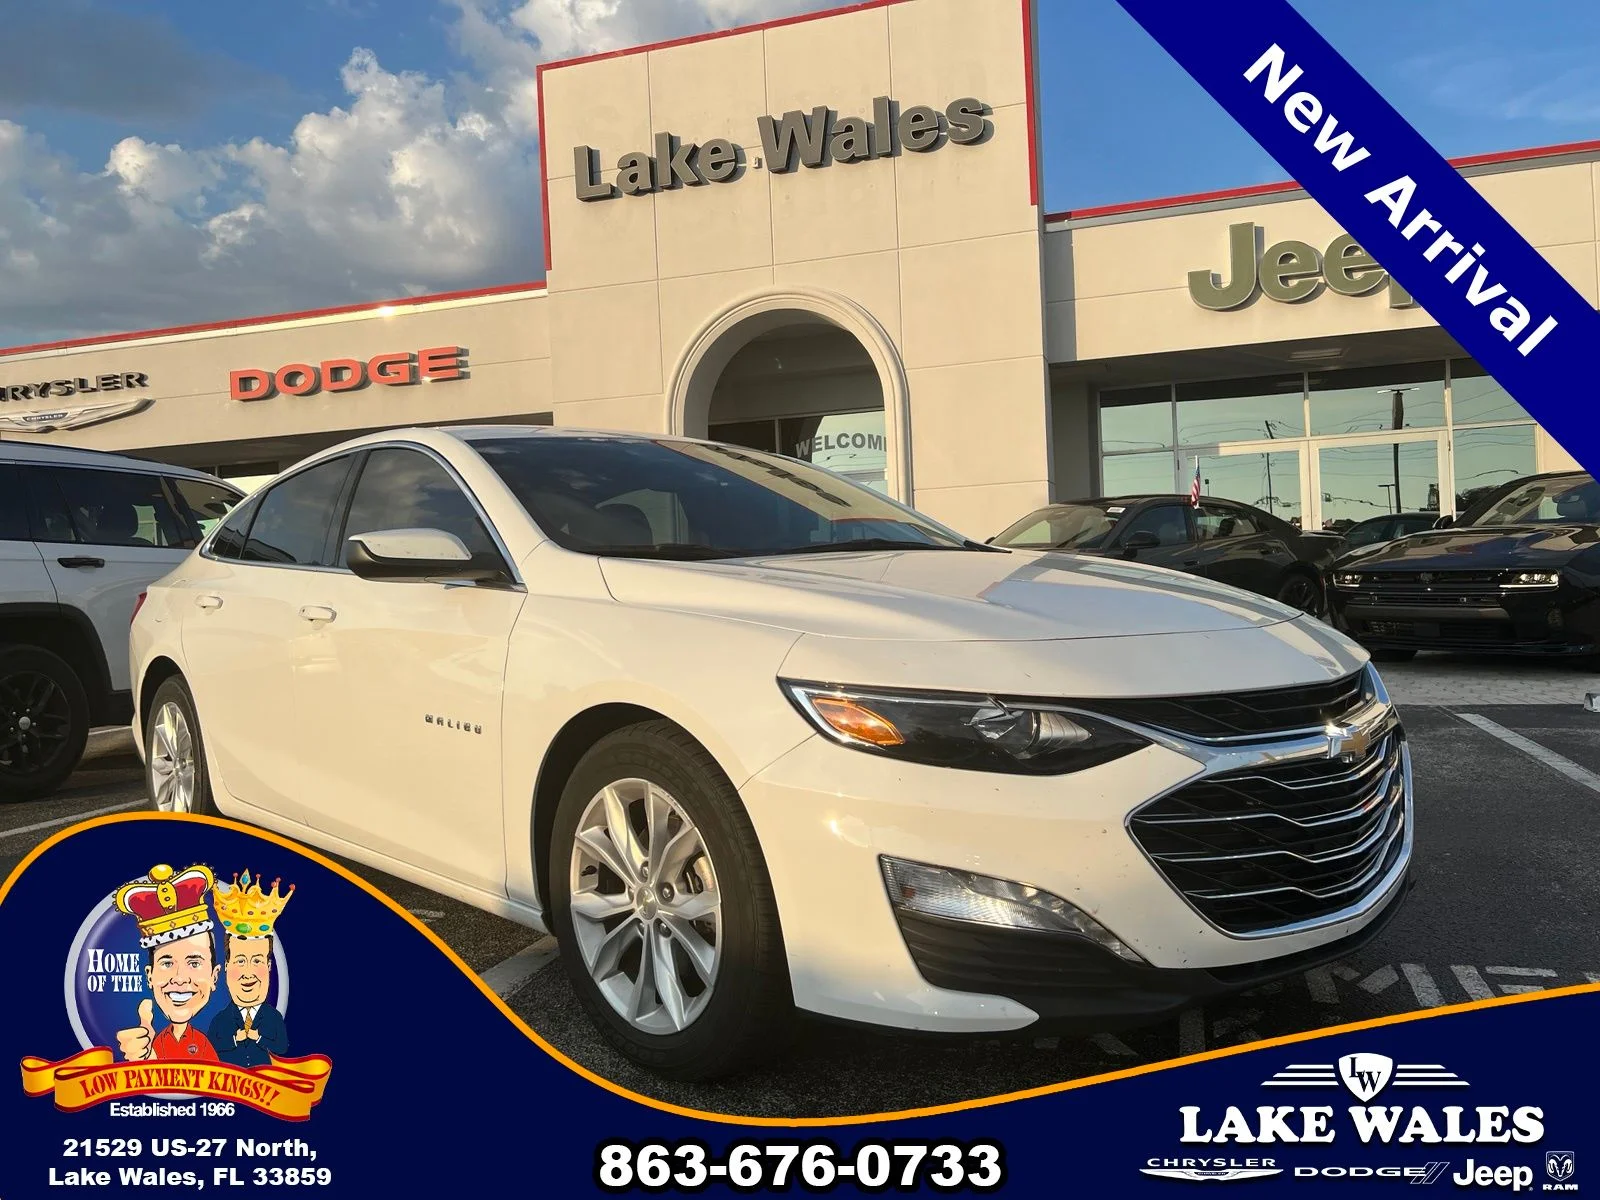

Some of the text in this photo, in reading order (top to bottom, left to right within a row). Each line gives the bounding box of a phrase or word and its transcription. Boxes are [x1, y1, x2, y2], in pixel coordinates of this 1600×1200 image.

[574, 95, 988, 201] Lake Wales
[0, 371, 149, 402] RYSLER
[230, 346, 468, 400] DODGE
[795, 432, 887, 458] WELCOM
[425, 713, 482, 735] MALIBU
